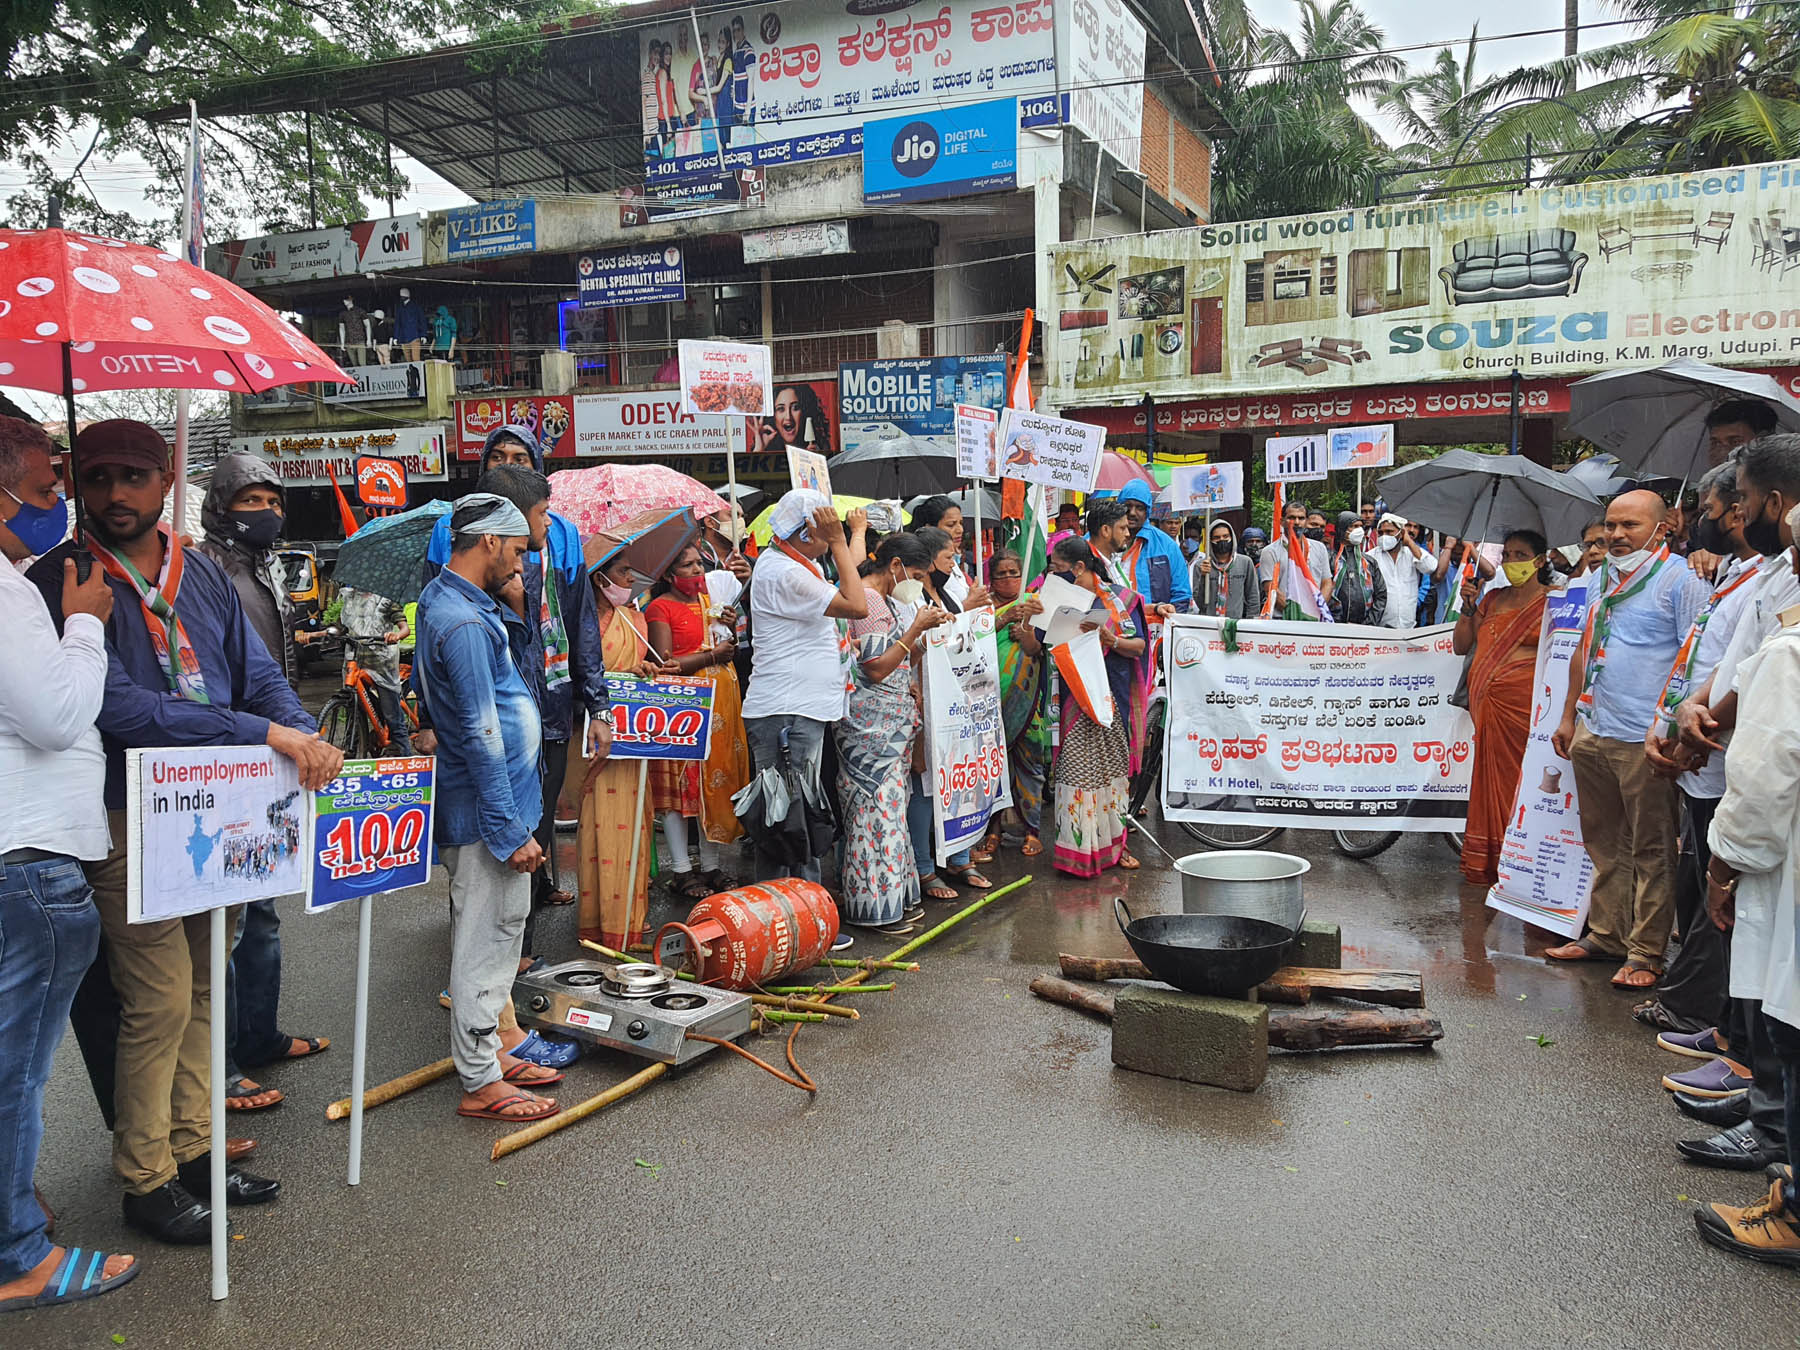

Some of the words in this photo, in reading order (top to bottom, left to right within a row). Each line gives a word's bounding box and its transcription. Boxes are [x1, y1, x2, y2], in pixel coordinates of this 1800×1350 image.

[759, 43, 821, 88] ಚಿತ್ರಾ
[945, 128, 988, 143] DIGITAL
[897, 135, 936, 163] Jio
[944, 143, 968, 155] LIFE
[656, 182, 723, 200] SO-FINE-TAILOR
[1201, 222, 1268, 248] Solid
[1279, 213, 1353, 241] wood
[1542, 169, 1745, 211] Customised
[1759, 162, 1800, 190] Fi
[449, 213, 517, 240] V-LIKE
[382, 232, 409, 253] ONN
[252, 250, 277, 270] ONN
[290, 261, 304, 270] ZEAL
[305, 258, 331, 268] FASHION
[581, 276, 608, 291] DENTAL
[609, 272, 652, 288] SPECIALITY
[654, 269, 681, 283] CLINIC
[584, 298, 624, 306] SPECIALISTS
[634, 293, 680, 302] APPOINTMENT
[1463, 353, 1524, 370] Church
[1531, 349, 1609, 366] Building,
[1616, 346, 1655, 360] K.M.
[1662, 344, 1713, 360] Marg,
[1720, 339, 1783, 356] Udupi.
[371, 379, 406, 392] FASHION
[843, 369, 932, 396] MOBILE
[842, 396, 931, 414] SOLUTION
[580, 432, 606, 441] SUPER
[608, 431, 641, 440] MARKET
[644, 431, 651, 439] &
[654, 430, 666, 438] ICE
[670, 429, 699, 438] CRAEM
[283, 457, 344, 478] RESTAURANT
[1302, 642, 1325, 657] ಯುವ
[1369, 696, 1410, 709] ಹಾಗೂ
[1417, 693, 1439, 707] ದಿನ
[611, 704, 703, 737] 100
[1316, 714, 1337, 727] ಬೆಲೆ
[652, 735, 697, 745] out
[1281, 735, 1398, 772] ಪ್ರತಿಭಟನಾ
[152, 758, 274, 785] Unemployment
[381, 773, 419, 788] ₹65
[1209, 777, 1223, 788] K1
[1228, 778, 1262, 791] Hotel,
[153, 794, 168, 815] in
[174, 789, 215, 813] India
[331, 857, 376, 879] not
[377, 849, 420, 869] out
